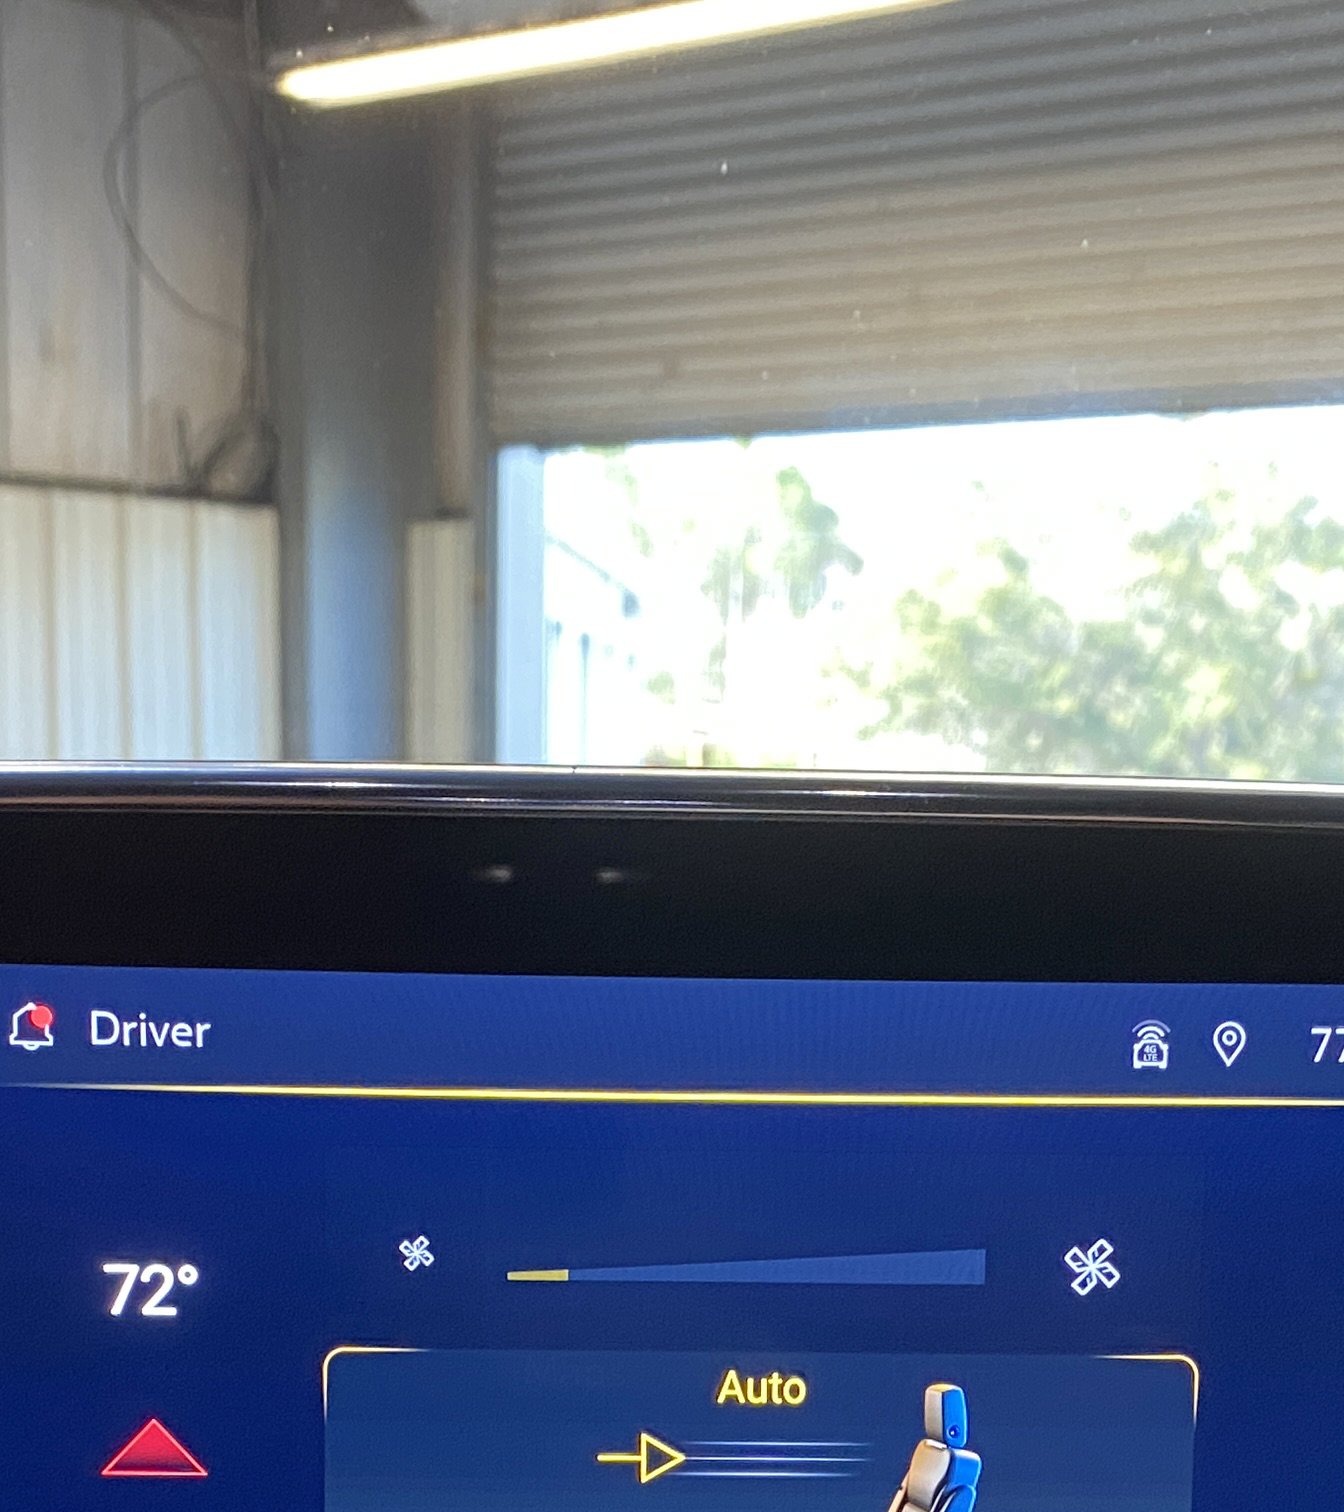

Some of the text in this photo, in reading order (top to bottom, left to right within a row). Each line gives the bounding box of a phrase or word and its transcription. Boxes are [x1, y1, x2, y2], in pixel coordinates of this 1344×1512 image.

[90, 1009, 212, 1048] Driver
[1143, 1044, 1157, 1053] 4G
[1143, 1053, 1158, 1062] LTE
[102, 1262, 199, 1317] 72°
[716, 1369, 807, 1406] Auto
